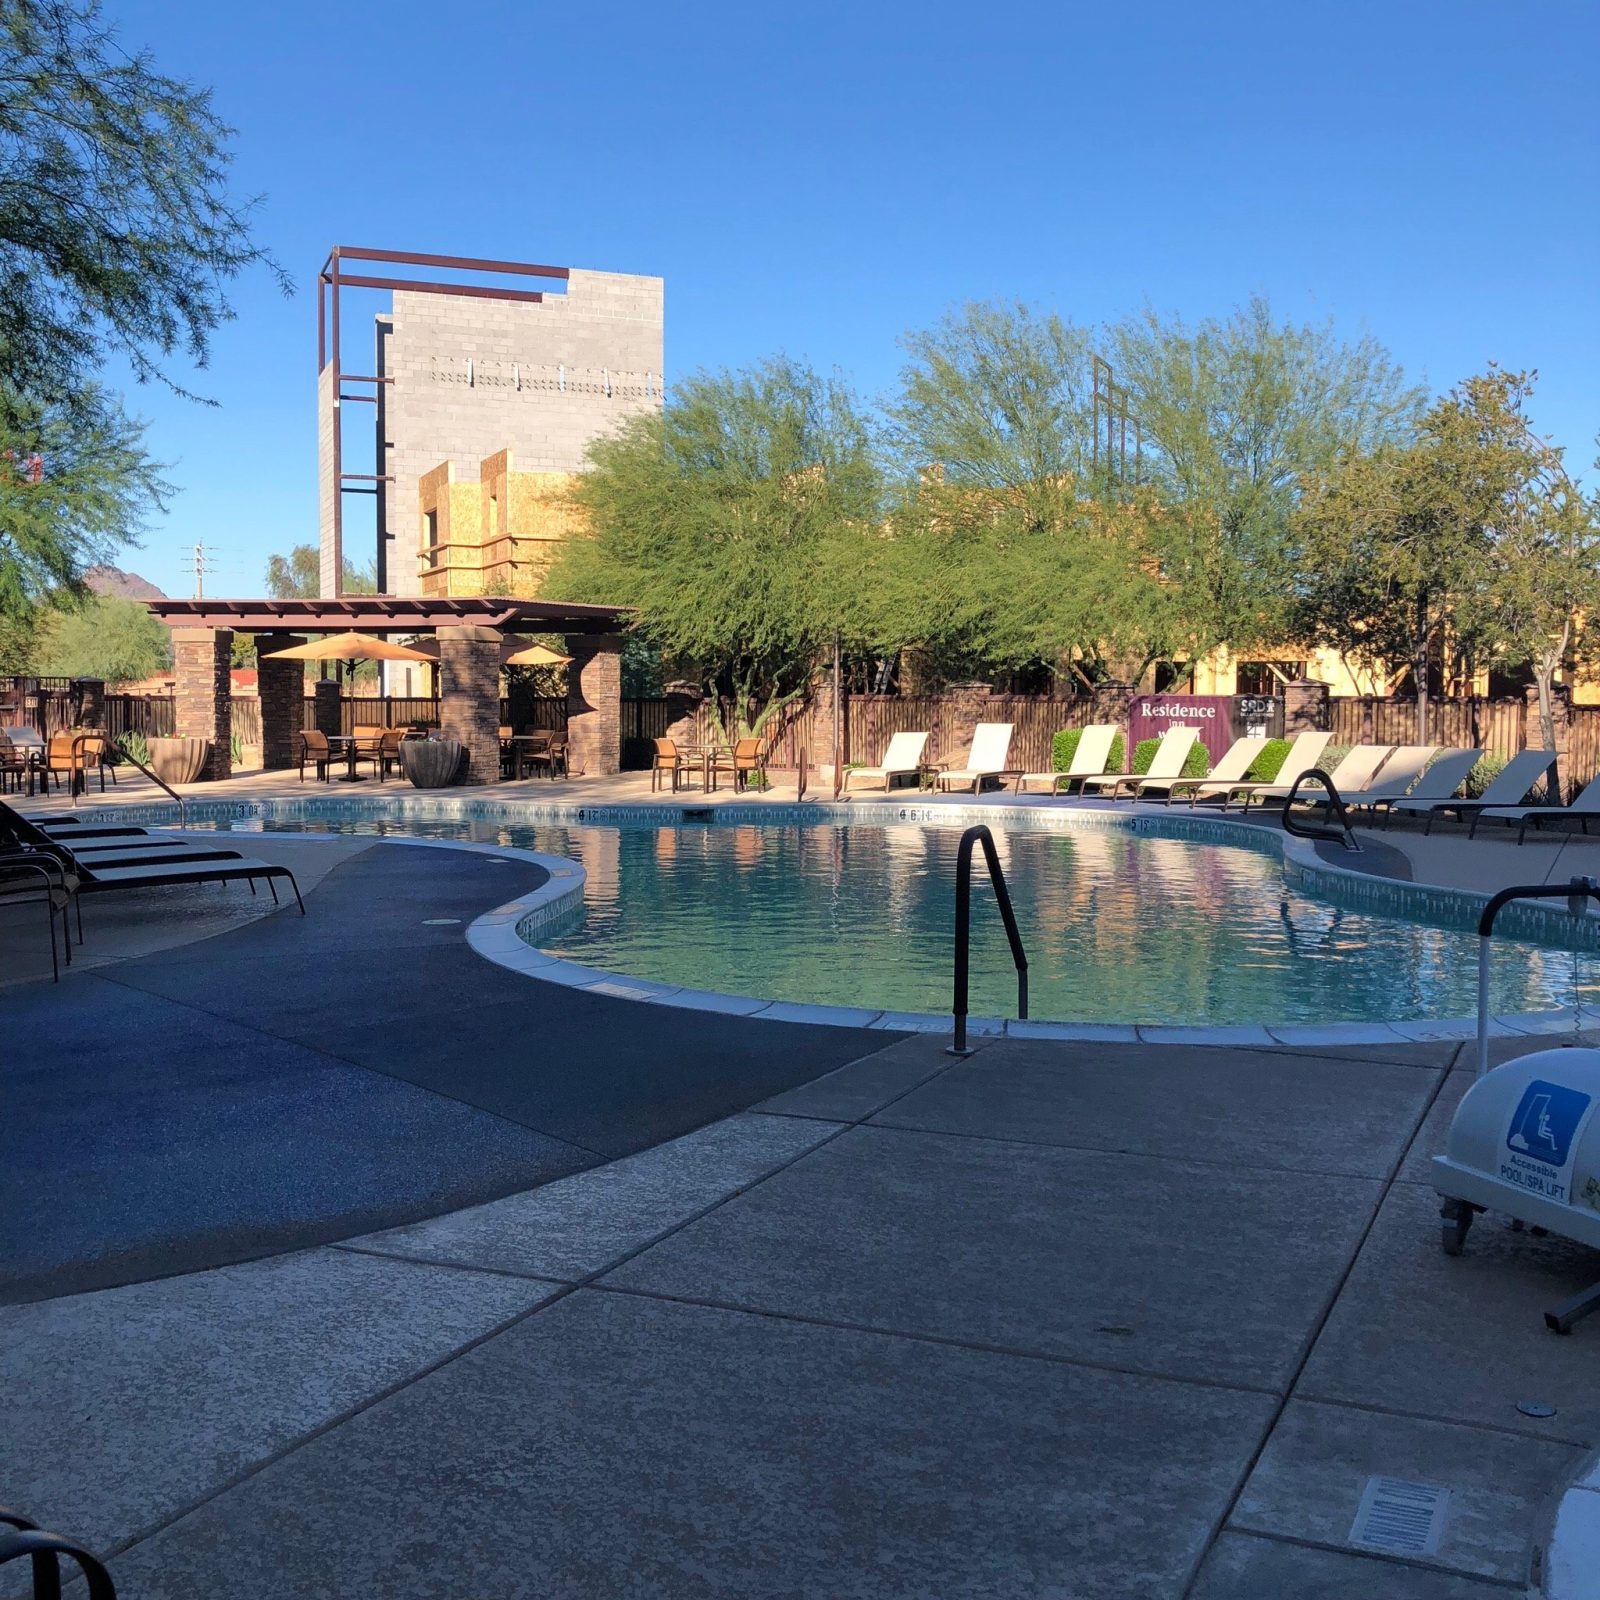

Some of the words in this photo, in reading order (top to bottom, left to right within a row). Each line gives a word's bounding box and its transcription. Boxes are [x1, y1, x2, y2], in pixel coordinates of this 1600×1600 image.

[1141, 702, 1216, 718] Residence
[1510, 1155, 1558, 1180] Accessible
[1501, 1164, 1548, 1194] POOL/SPA
[1546, 1183, 1566, 1199] LIFT
